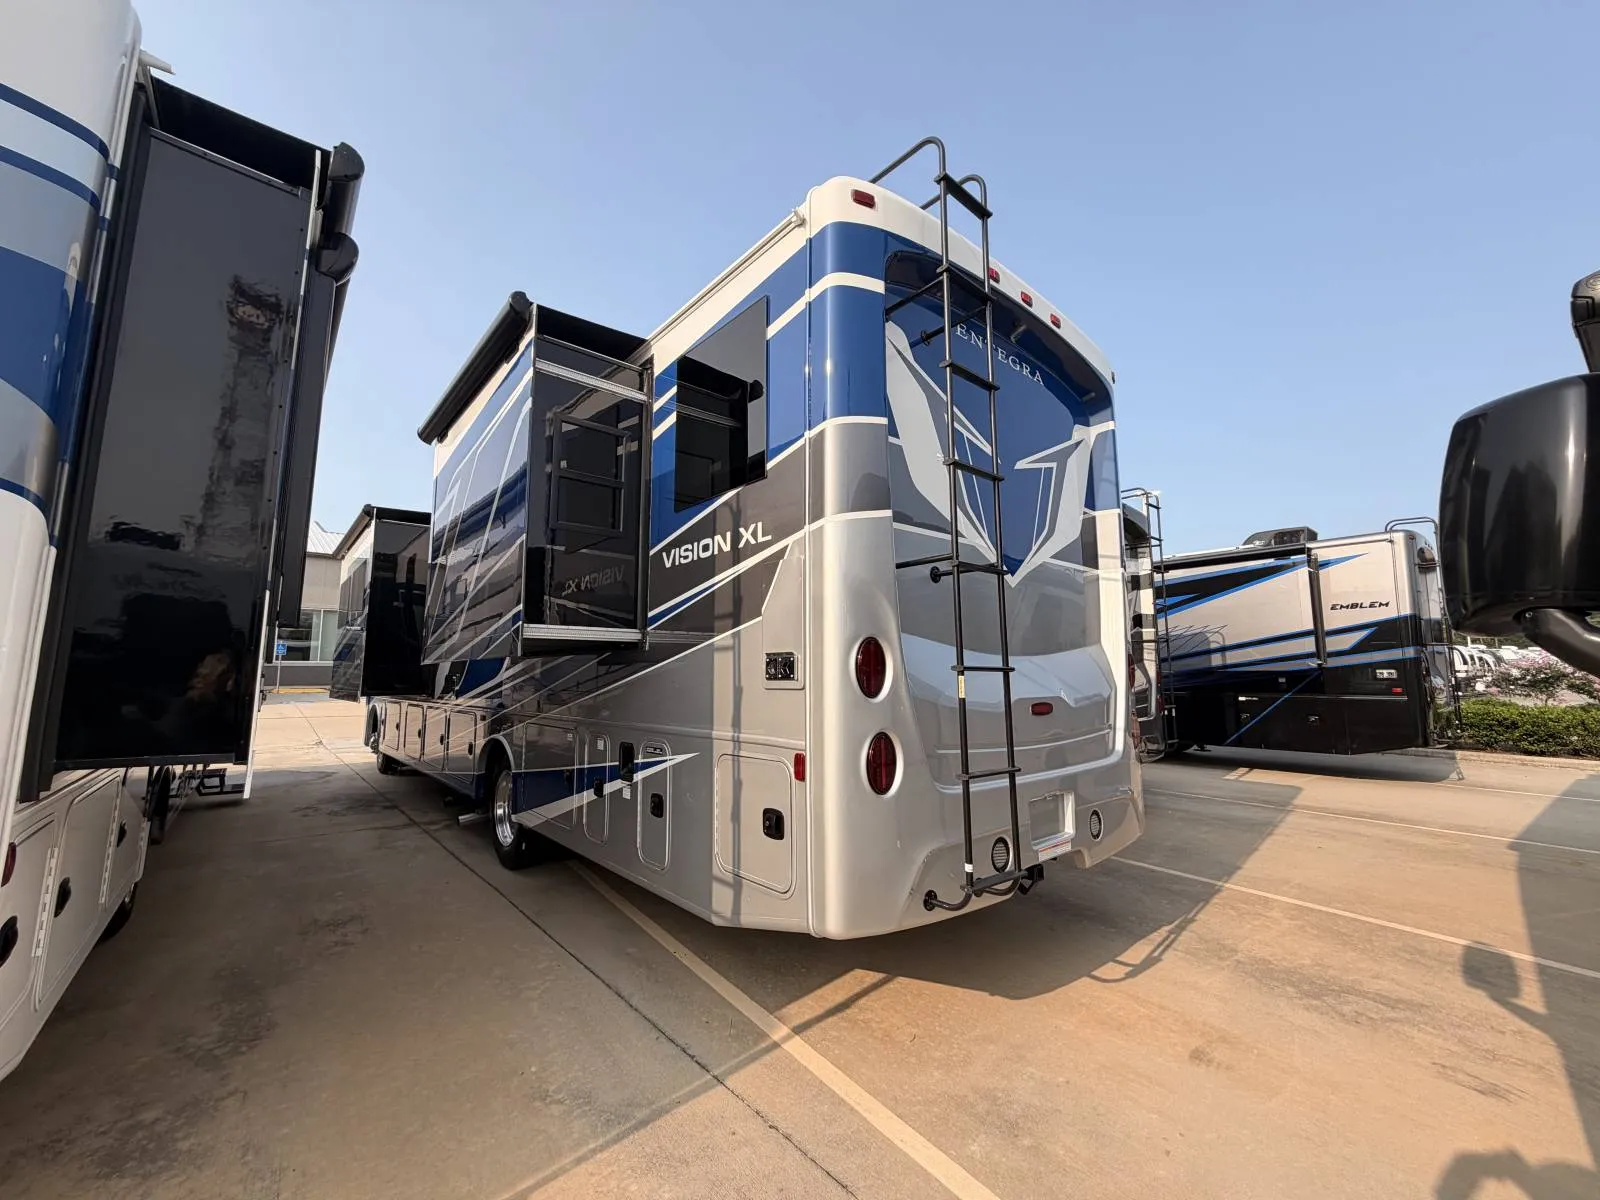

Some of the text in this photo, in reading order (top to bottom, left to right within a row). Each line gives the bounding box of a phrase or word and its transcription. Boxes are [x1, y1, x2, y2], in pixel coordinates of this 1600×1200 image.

[955, 323, 1045, 386] ENEGRA
[662, 521, 772, 569] VISION XL
[1330, 600, 1390, 611] EMBLEM
